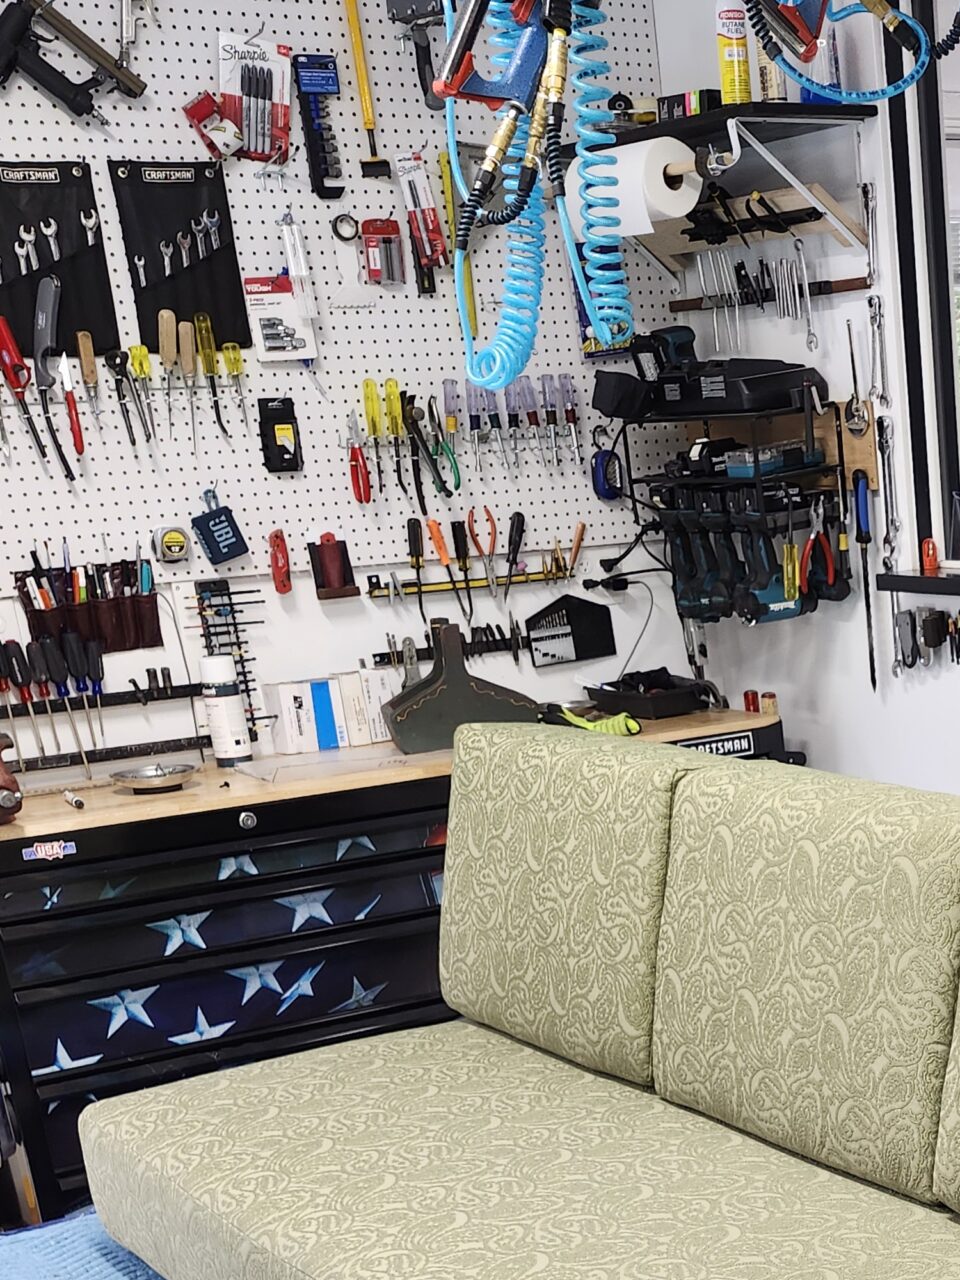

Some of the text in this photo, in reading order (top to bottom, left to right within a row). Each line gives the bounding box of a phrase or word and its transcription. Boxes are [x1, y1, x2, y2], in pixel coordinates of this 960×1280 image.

[221, 44, 269, 62] Sharpie
[3, 170, 57, 180] CRAFTSMAN
[145, 170, 192, 180] CRAFTSMAN
[208, 515, 237, 554] JBL
[36, 843, 61, 857] USA
